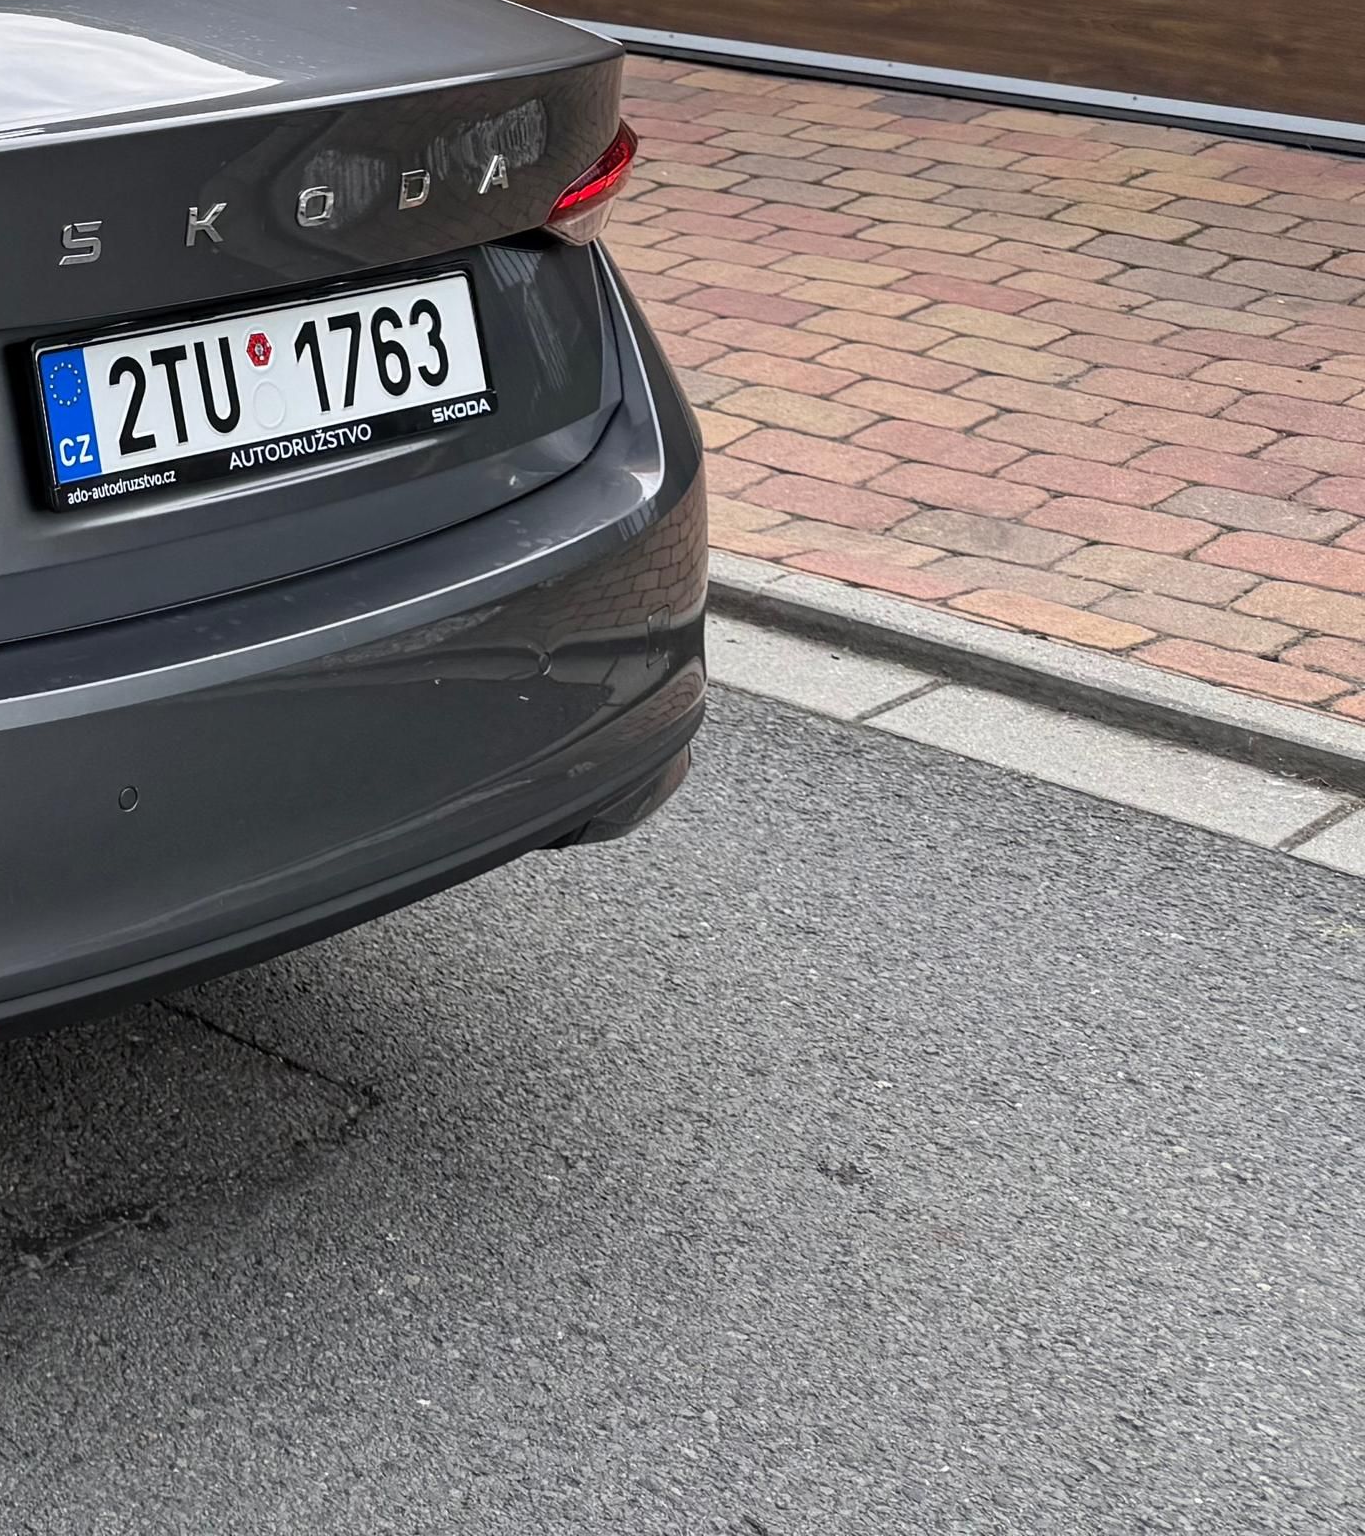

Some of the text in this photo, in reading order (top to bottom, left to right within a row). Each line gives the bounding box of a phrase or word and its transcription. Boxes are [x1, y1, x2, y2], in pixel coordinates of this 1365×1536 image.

[108, 298, 450, 456] 2TU 1763
[59, 433, 95, 468] CZ
[229, 423, 372, 471] AUTODRUŽSTVO
[67, 470, 177, 505] ado-autodruzstvo.cz
